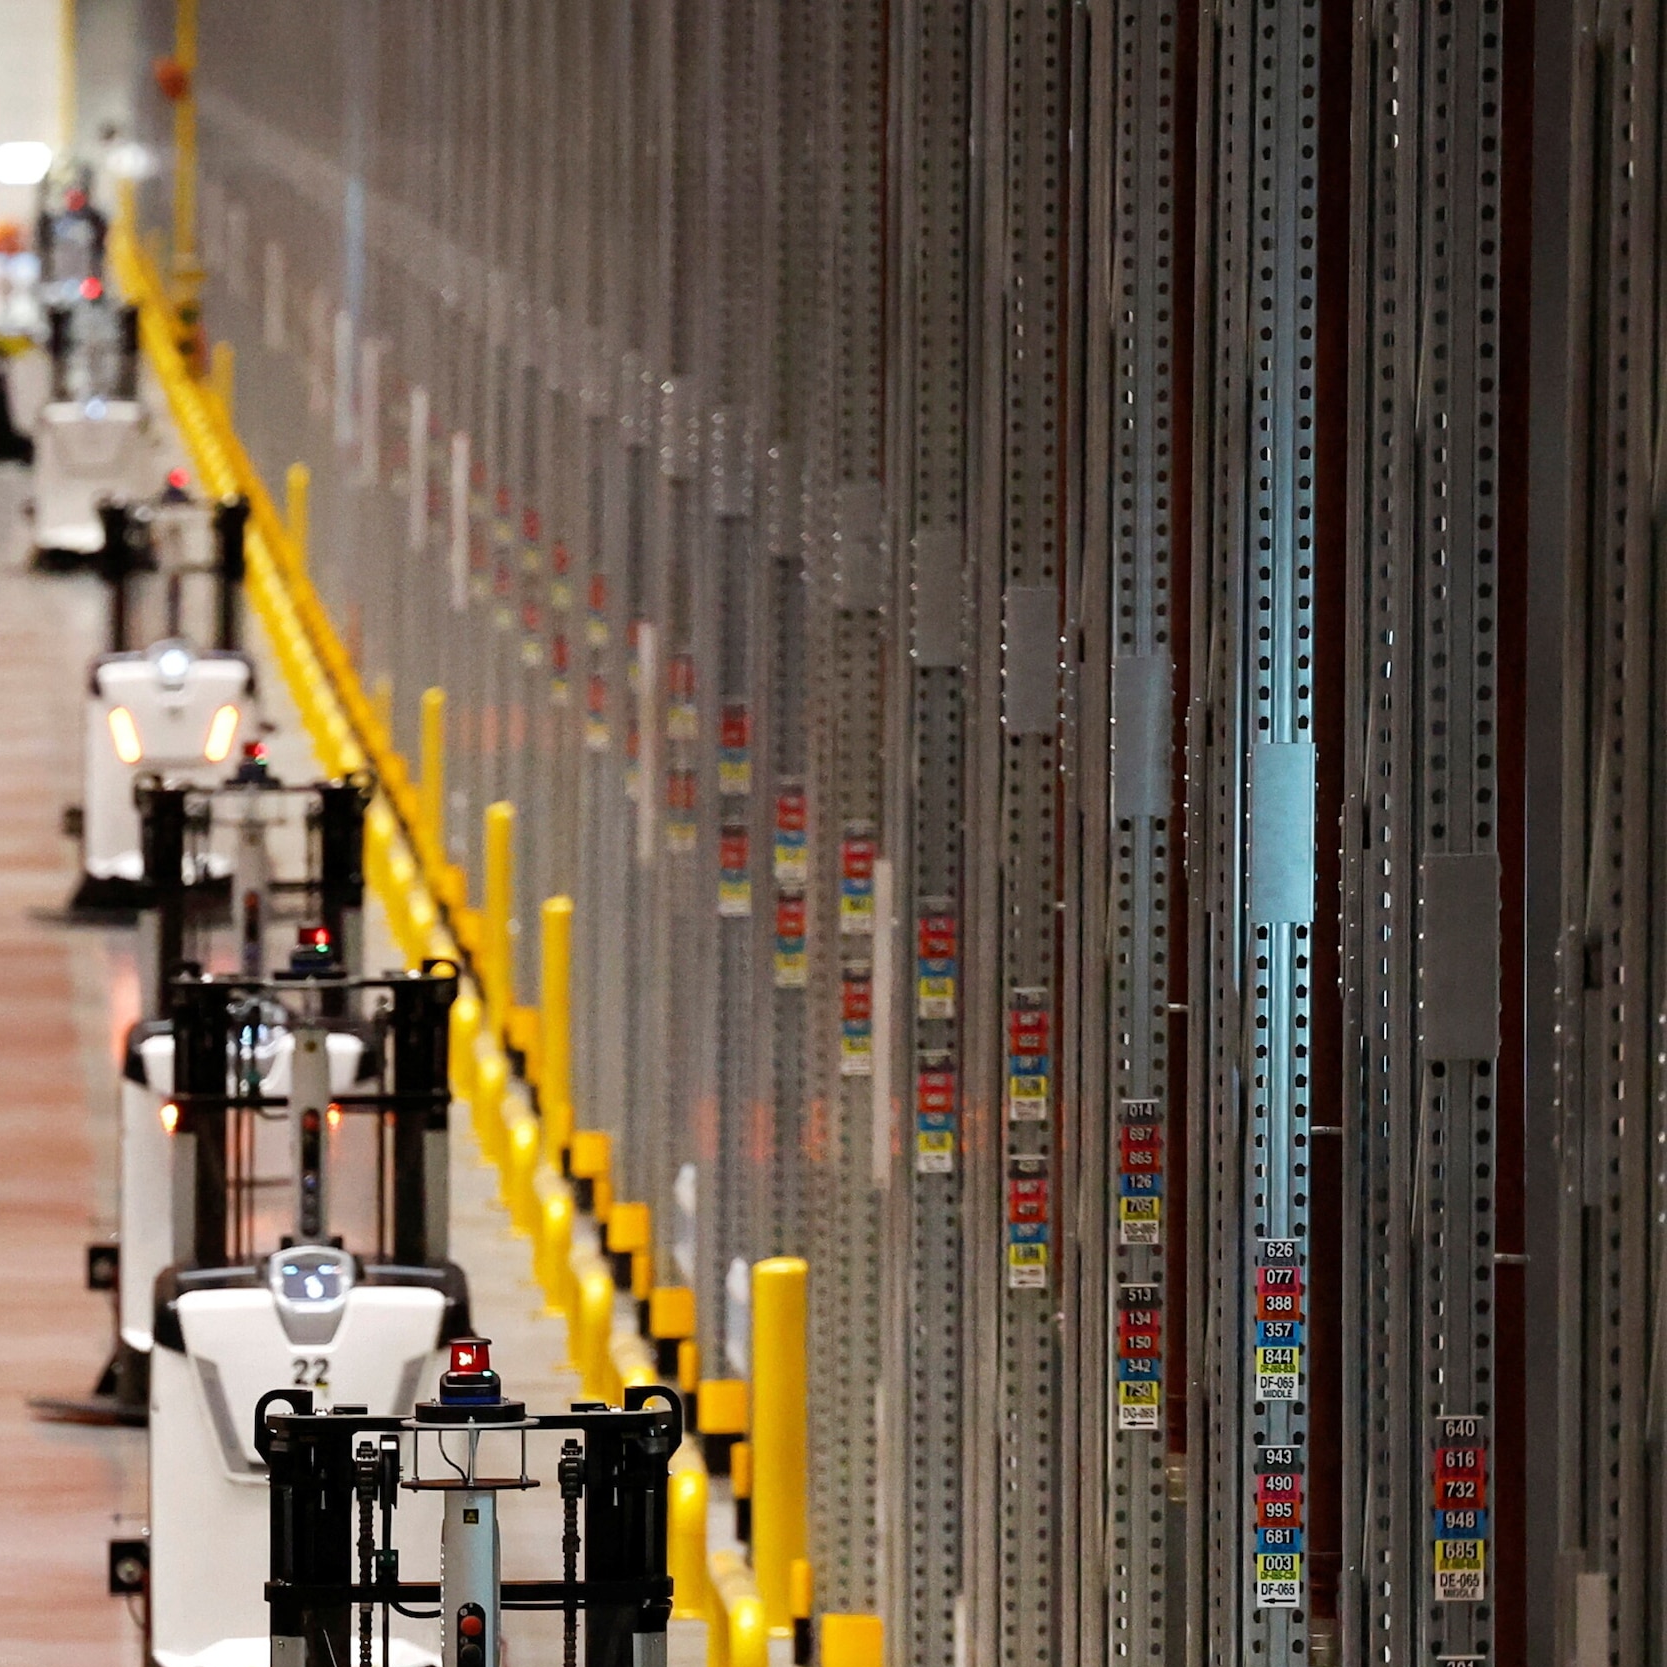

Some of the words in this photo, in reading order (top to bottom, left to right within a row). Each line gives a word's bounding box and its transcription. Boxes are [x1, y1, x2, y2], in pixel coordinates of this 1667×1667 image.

[1129, 1104, 1152, 1117] 014
[1129, 1152, 1152, 1165] 865
[1129, 1175, 1152, 1189] 126
[1129, 1199, 1152, 1212] 705
[1266, 1242, 1292, 1257] 626
[1266, 1269, 1292, 1284] 077
[1128, 1288, 1151, 1301] 513
[1266, 1296, 1292, 1311] 388
[1128, 1312, 1151, 1326] 134
[1266, 1322, 1292, 1337] 357
[1128, 1336, 1151, 1349] 150
[1266, 1349, 1292, 1364] 844
[292, 1358, 330, 1386] 22
[1128, 1359, 1151, 1373] 342
[1260, 1376, 1294, 1389] DF-065
[1263, 1389, 1293, 1398] MIDDLE
[1446, 1420, 1475, 1437] 640
[1266, 1449, 1292, 1464] 943
[1446, 1451, 1475, 1468] 616
[1266, 1476, 1292, 1491] 490
[1446, 1481, 1475, 1498] 732
[1266, 1503, 1292, 1518] 995
[1446, 1511, 1475, 1528] 948
[1266, 1529, 1292, 1544] 681
[1446, 1541, 1475, 1559] 685
[1266, 1556, 1292, 1571] 003
[1440, 1573, 1480, 1588] DE-065
[1261, 1583, 1295, 1595] DF-065
